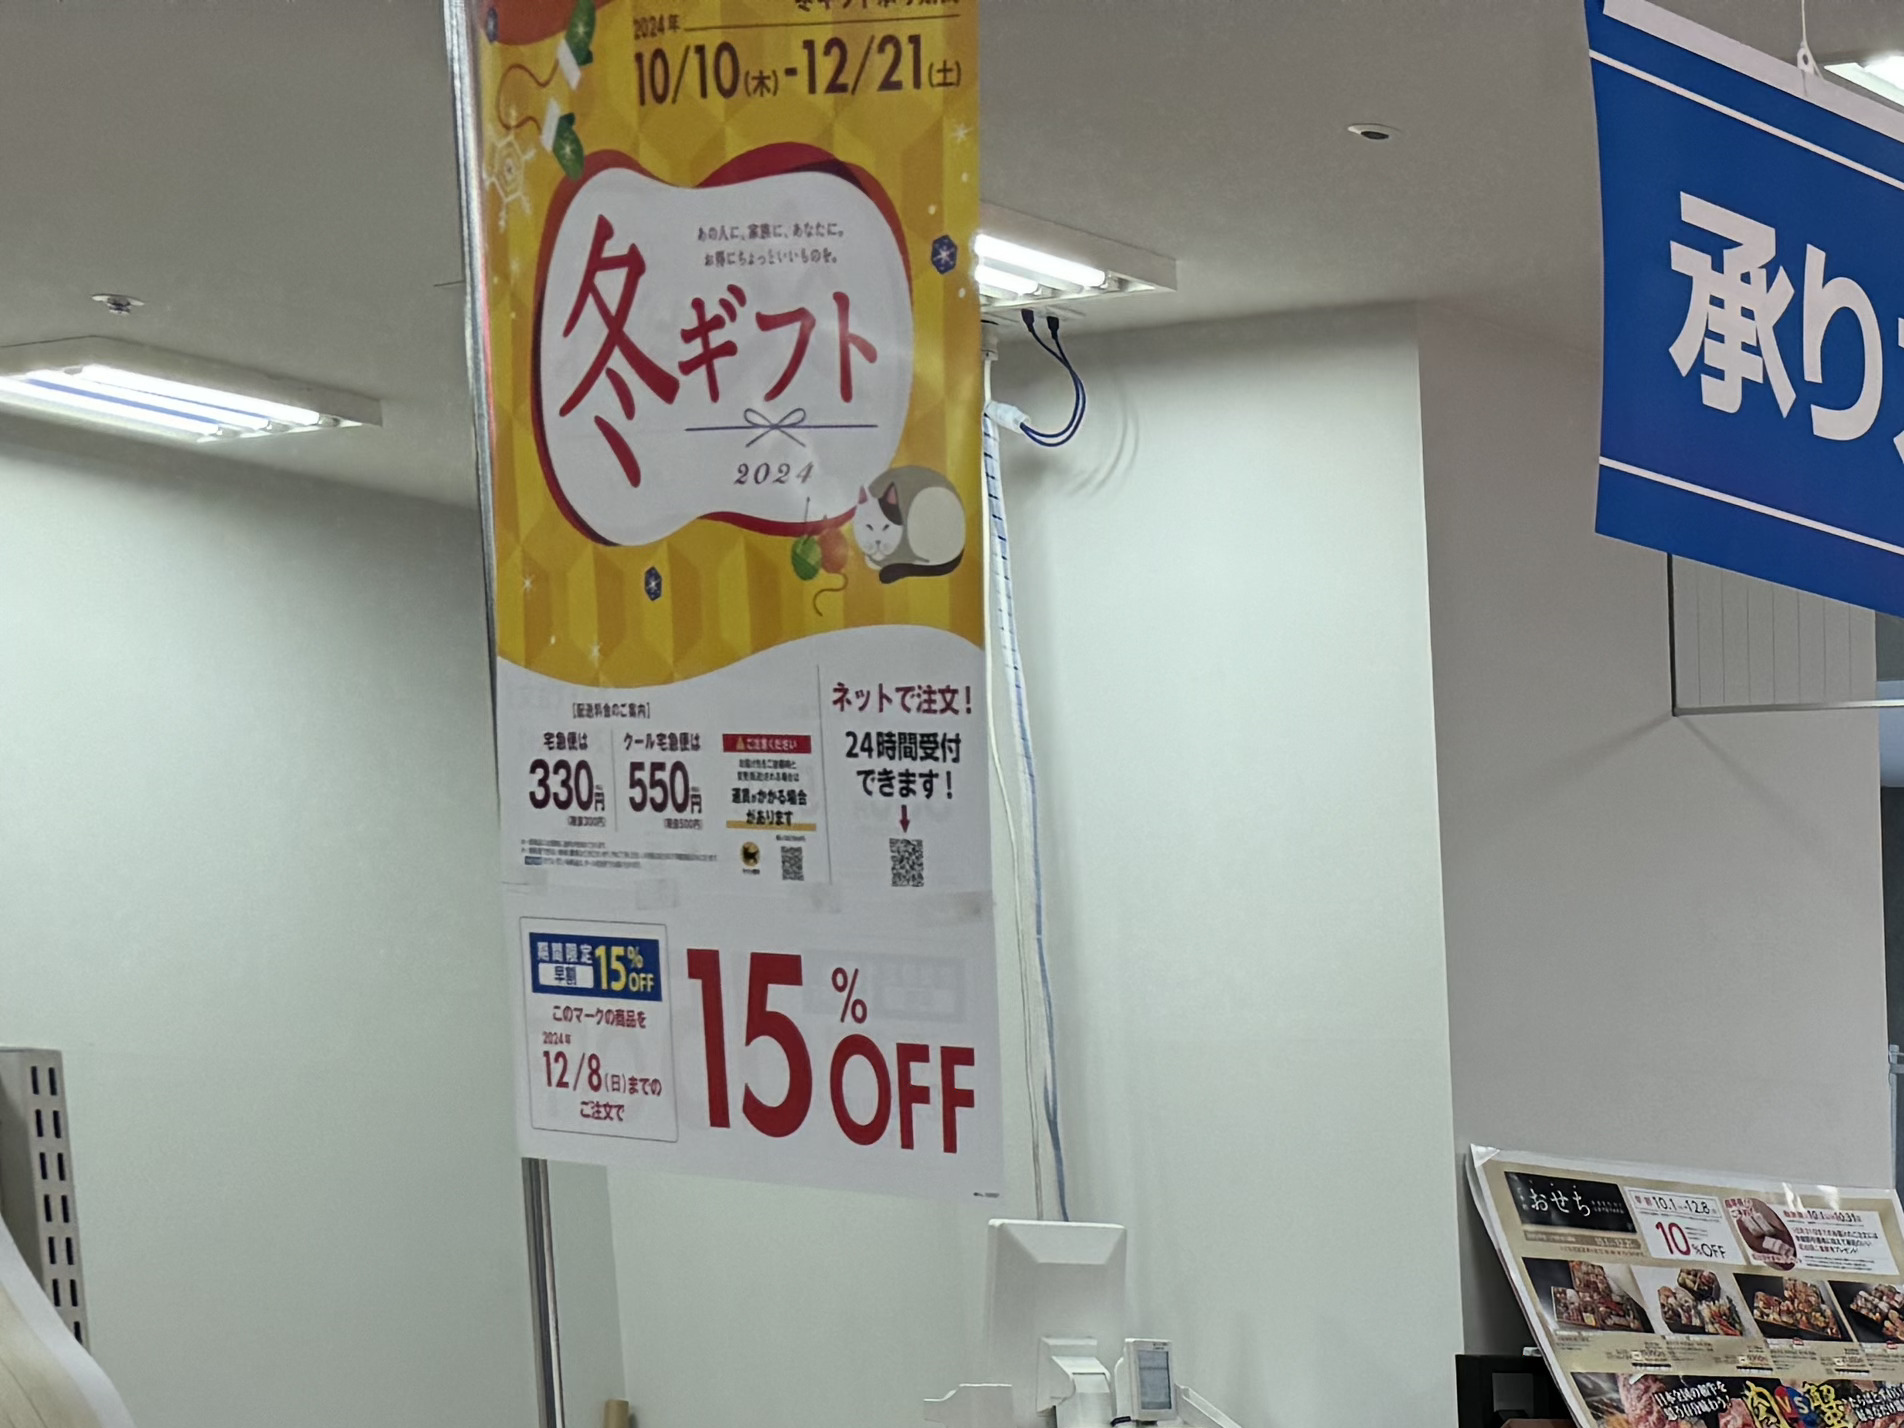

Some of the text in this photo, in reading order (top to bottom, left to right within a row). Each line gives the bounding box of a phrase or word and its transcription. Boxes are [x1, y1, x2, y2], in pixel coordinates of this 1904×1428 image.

[633, 14, 680, 39] 2024年
[634, 34, 962, 106] 10/10(木)-12/21(土)
[558, 213, 878, 487] 冬ギフト
[734, 461, 814, 486] 2024
[832, 682, 972, 716] ネットで注文!
[543, 732, 588, 751] 宅急便は
[624, 732, 700, 751] クール宅急便は
[845, 731, 961, 764] 24時間受付
[857, 769, 952, 799] できます!
[552, 1004, 647, 1029] このマークの商品を
[579, 1101, 625, 1122] ご注文で
